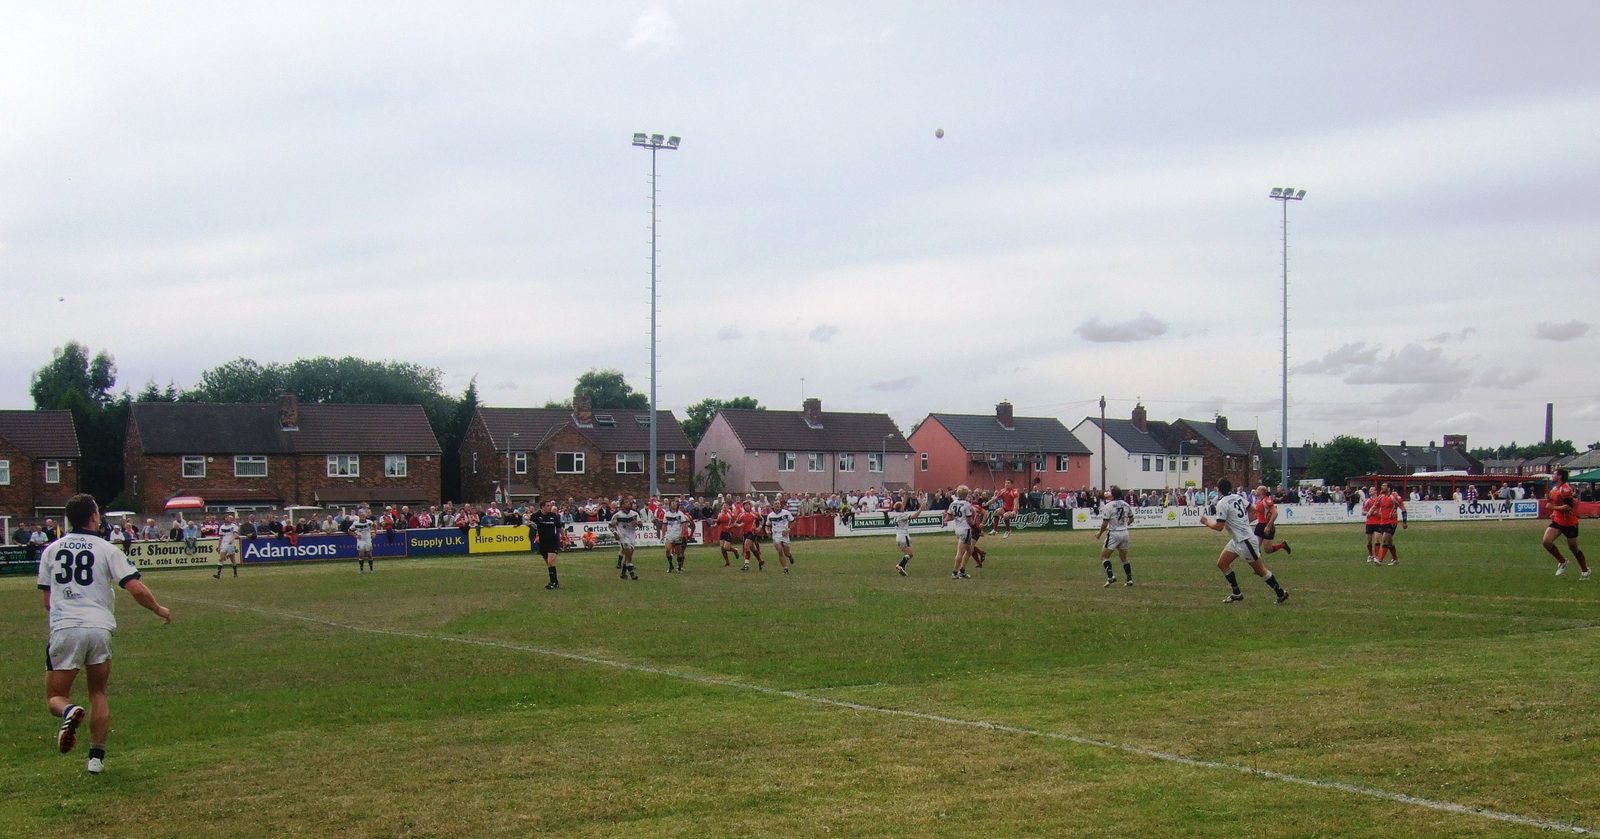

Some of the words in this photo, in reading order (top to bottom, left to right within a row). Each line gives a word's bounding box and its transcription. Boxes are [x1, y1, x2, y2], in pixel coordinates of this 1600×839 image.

[952, 505, 962, 518] 36
[1182, 508, 1199, 516] Abel
[1518, 503, 1536, 511] group
[1116, 508, 1124, 520] 7
[411, 538, 443, 548] Supply
[446, 537, 464, 545] U.K.
[475, 536, 493, 544] Hire
[496, 534, 524, 543] Shops
[244, 542, 336, 558] Adamsons
[55, 549, 94, 586] 38
